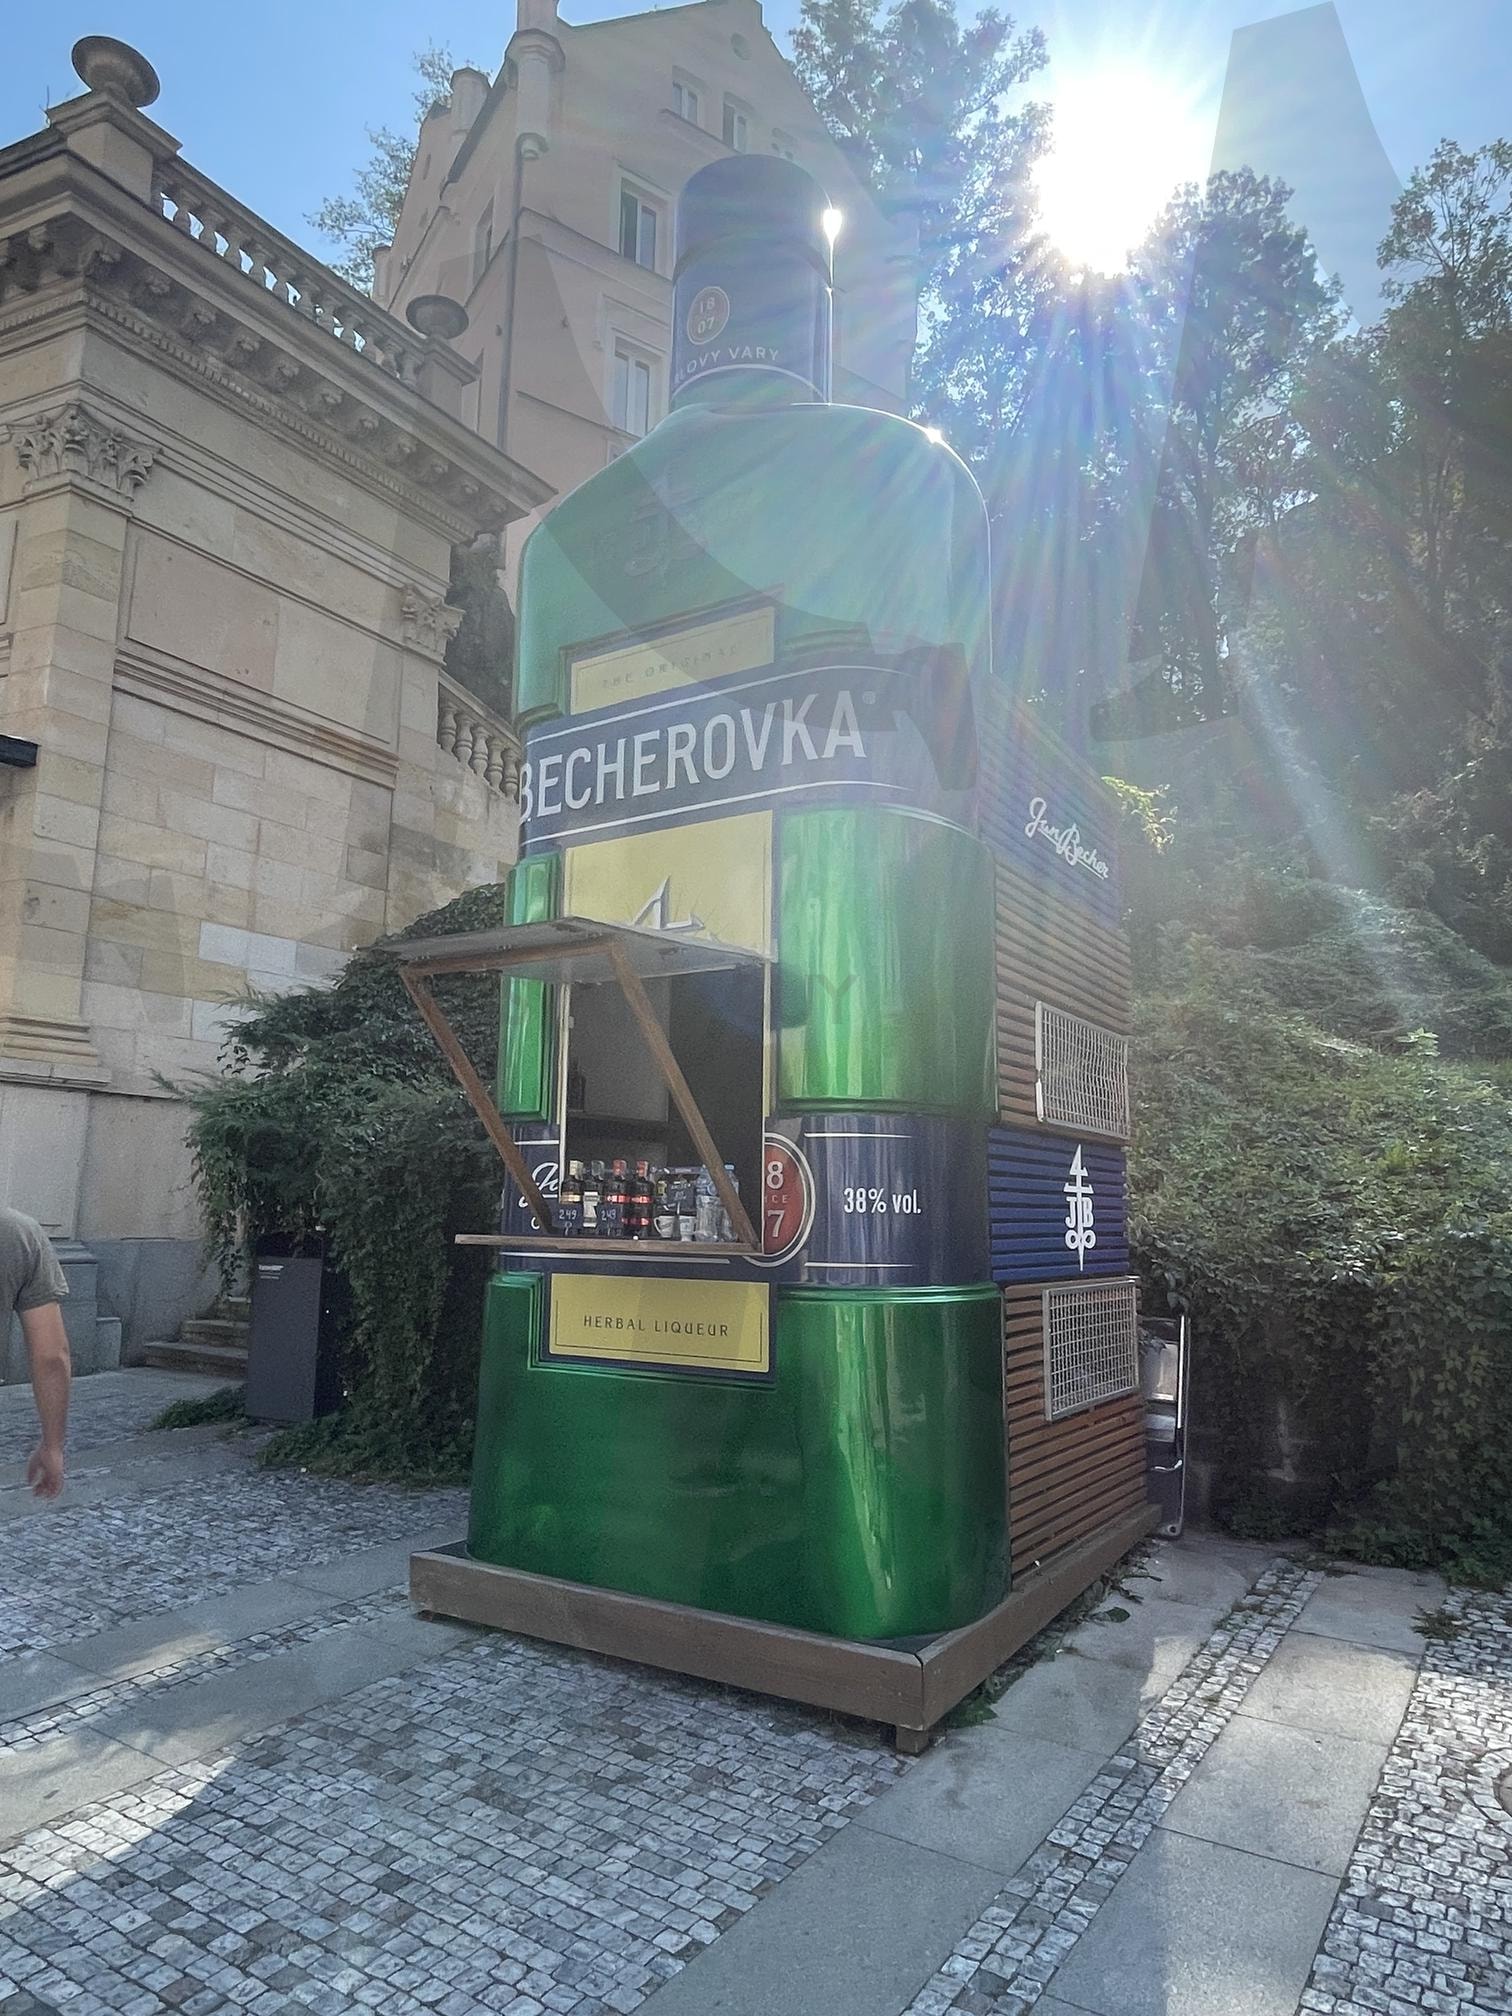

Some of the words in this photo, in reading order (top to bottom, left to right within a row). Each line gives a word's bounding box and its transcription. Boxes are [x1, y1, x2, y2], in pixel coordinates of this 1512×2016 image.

[728, 346, 779, 361] VARY
[843, 1187, 887, 1214] 38%
[892, 1189, 922, 1214] vol.
[559, 1209, 577, 1220] 249
[583, 1315, 646, 1332] HERBAL
[654, 1319, 729, 1337] LIQUEUR
